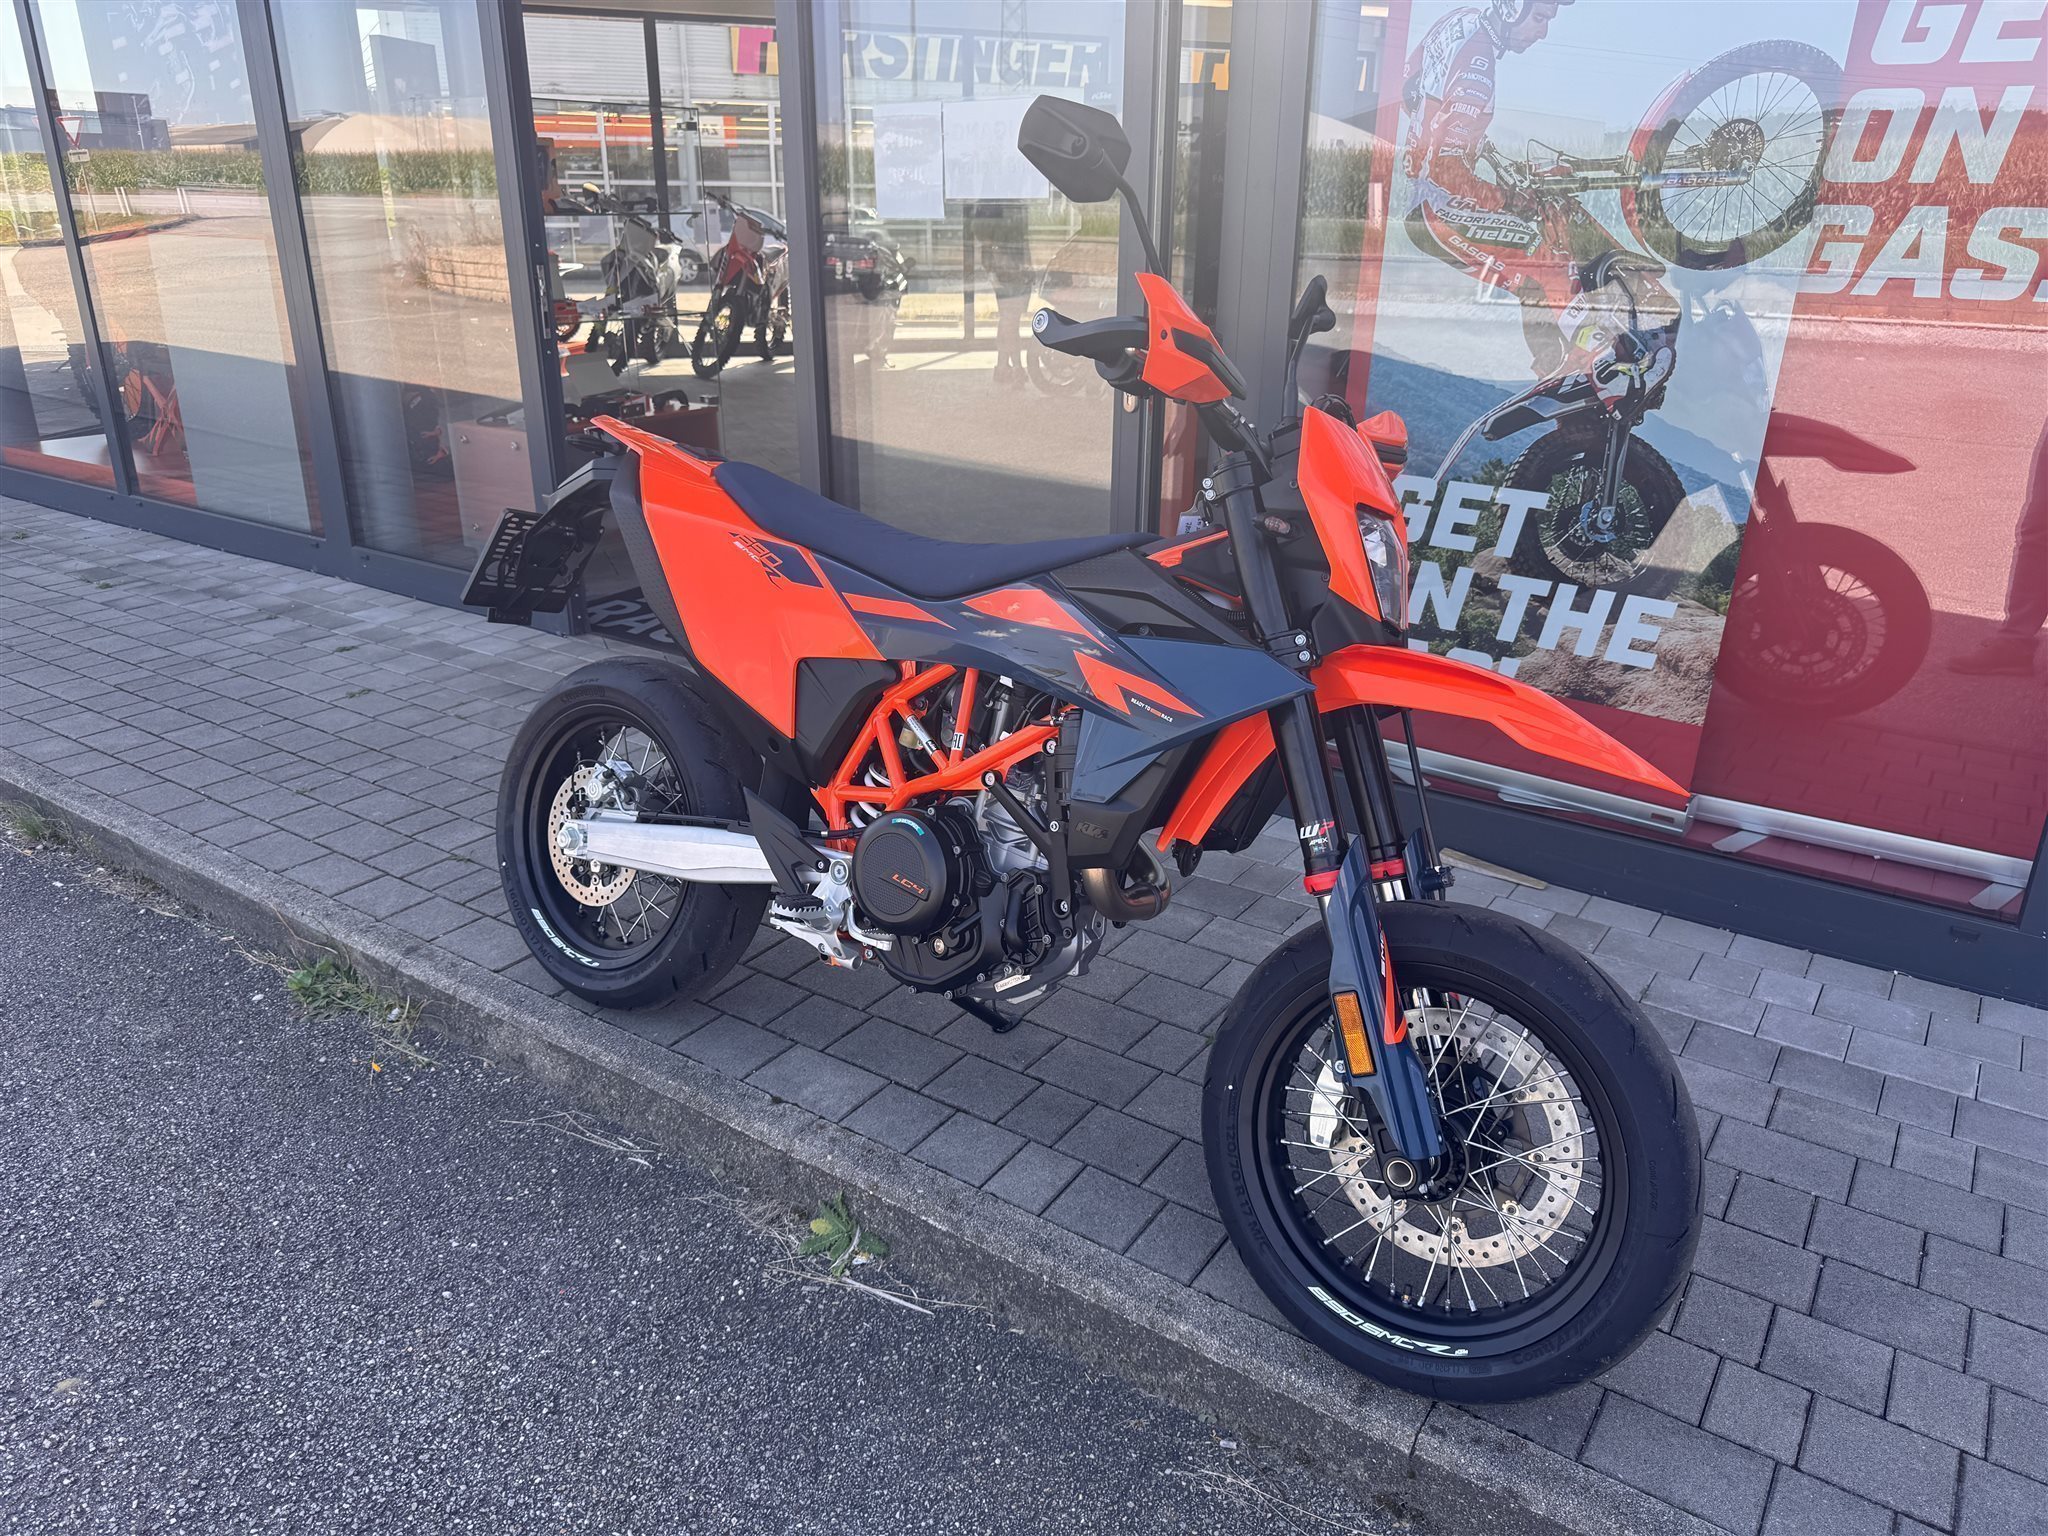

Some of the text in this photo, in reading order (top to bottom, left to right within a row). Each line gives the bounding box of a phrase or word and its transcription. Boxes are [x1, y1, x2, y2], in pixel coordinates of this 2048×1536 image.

[1823, 86, 2035, 184] ON
[1435, 207, 1491, 227] FACTORY
[1448, 235, 1506, 272] GASGAS
[1393, 474, 1551, 559] GET
[1408, 560, 1475, 632] N
[1496, 573, 1679, 670] THE
[1130, 697, 1174, 723] READY TO RACE
[891, 873, 925, 895] LC4
